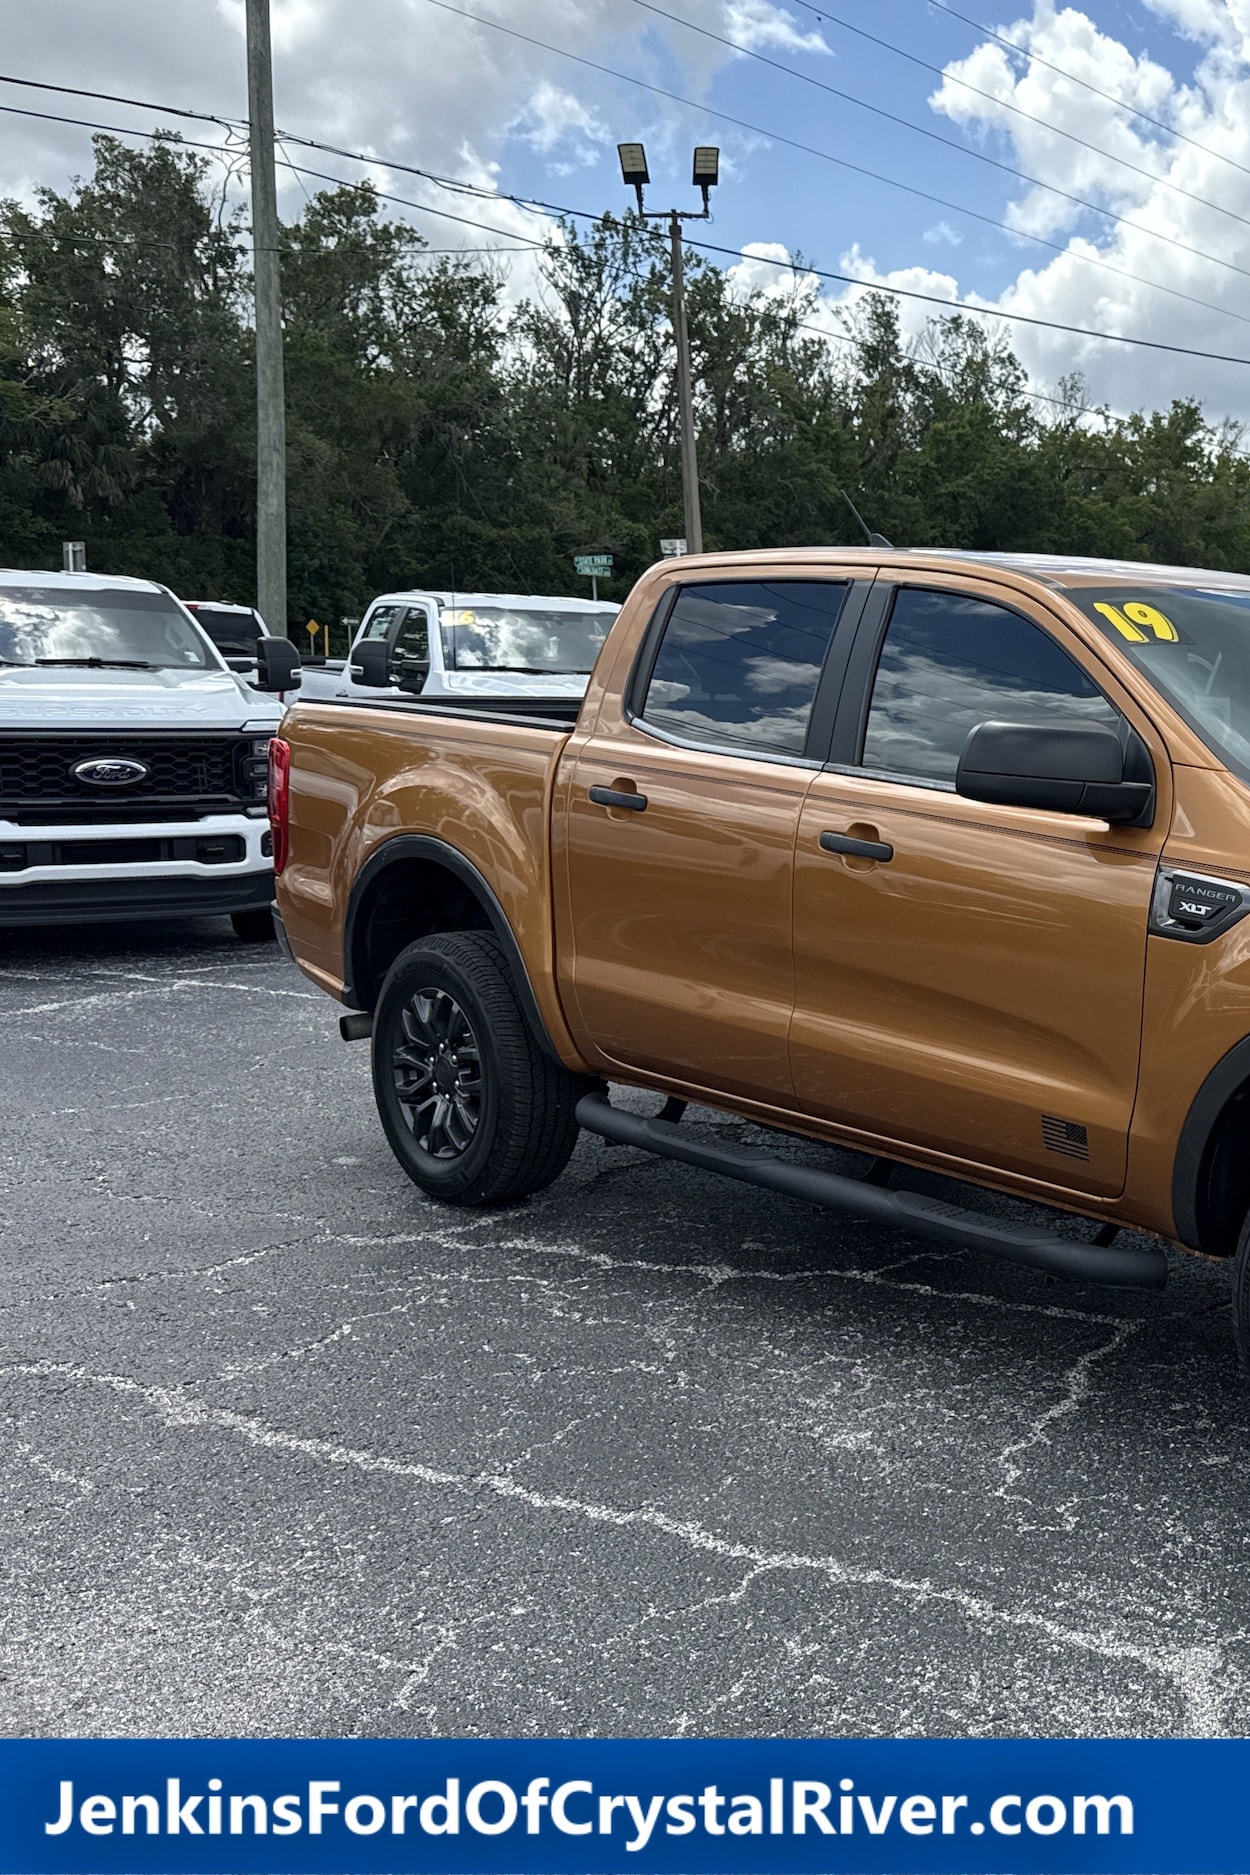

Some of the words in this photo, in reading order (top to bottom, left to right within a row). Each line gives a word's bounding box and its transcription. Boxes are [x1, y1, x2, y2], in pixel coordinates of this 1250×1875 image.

[1093, 602, 1179, 643] 19
[122, 705, 208, 718] DUTY
[92, 764, 131, 780] Ford
[1174, 883, 1236, 902] RANGER
[1178, 901, 1212, 915] XLT
